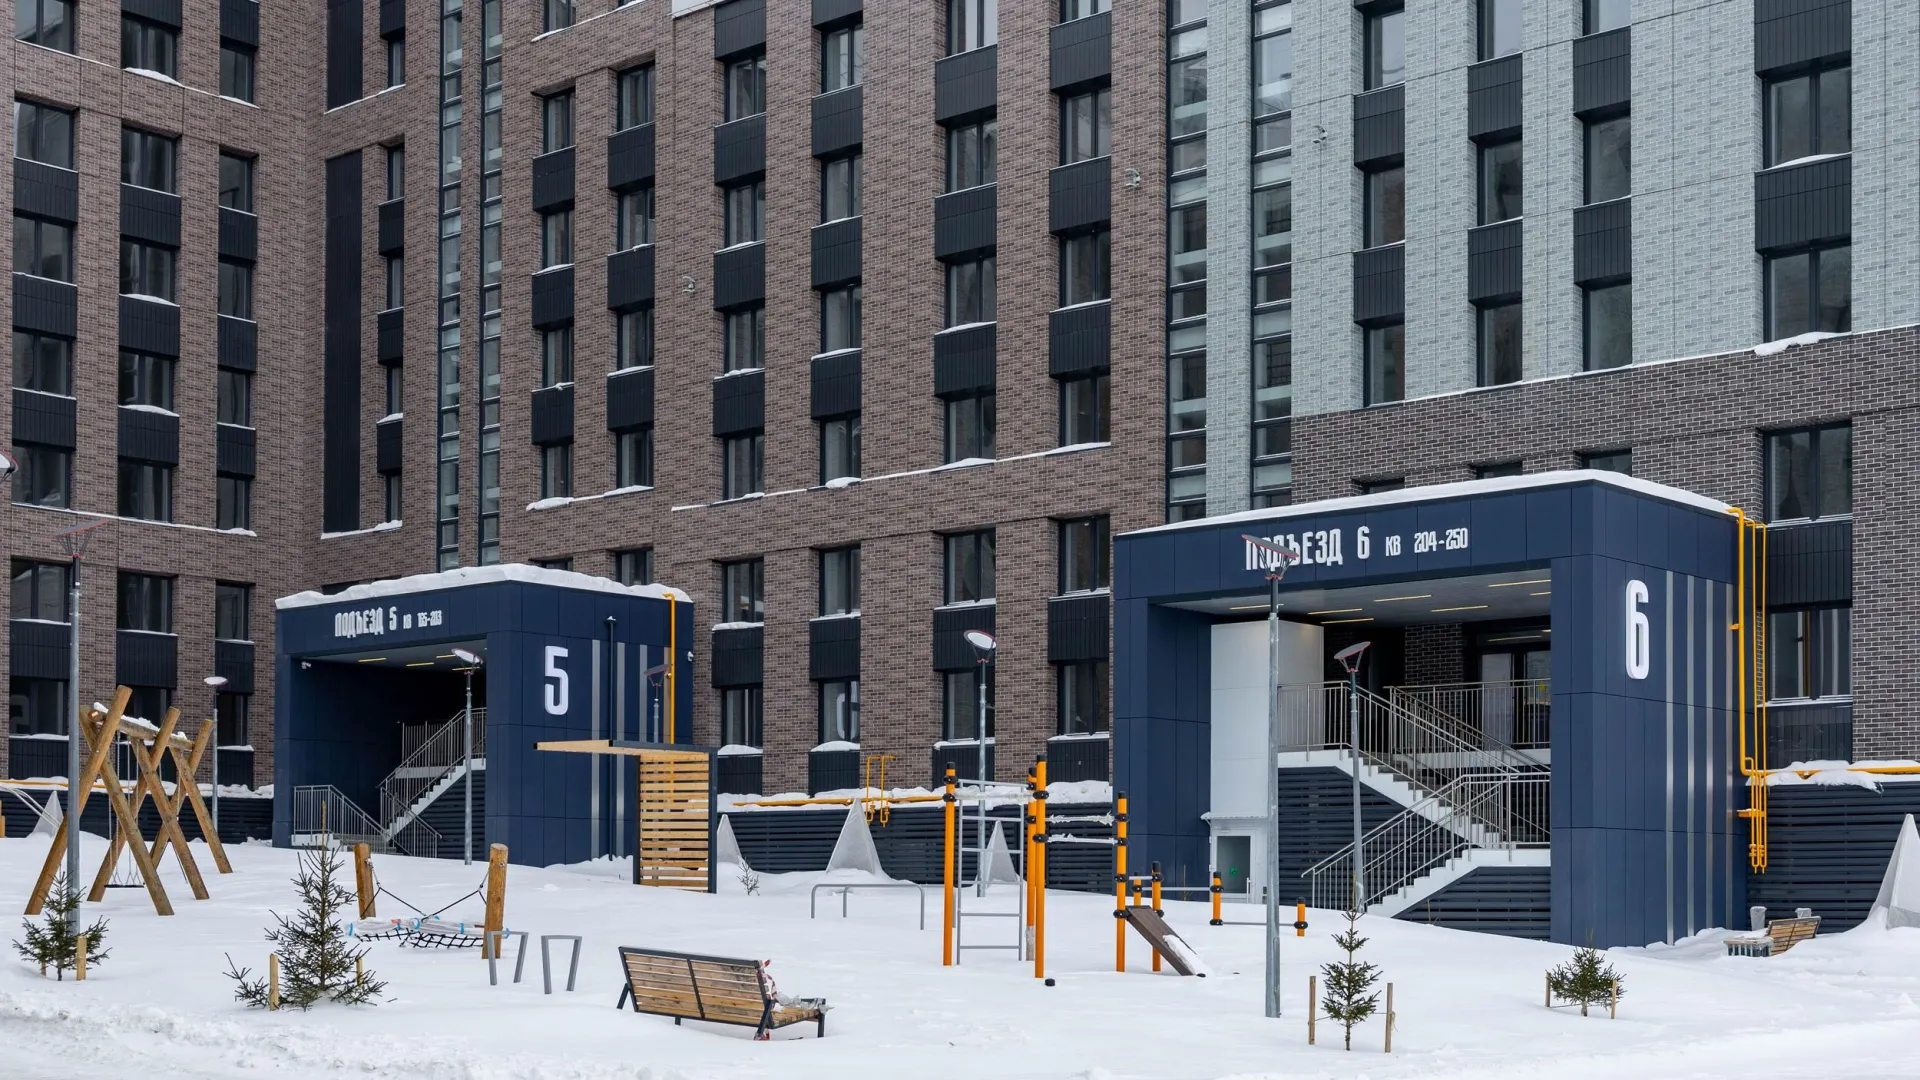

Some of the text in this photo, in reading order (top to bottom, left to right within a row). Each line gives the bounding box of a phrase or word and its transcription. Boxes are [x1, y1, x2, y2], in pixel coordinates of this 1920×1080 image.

[1245, 525, 1469, 572] ПОДЪЕЗД 6 КВ 204-250
[334, 606, 384, 639] ПОДЪЕЗД
[389, 606, 397, 631] 5
[1625, 579, 1651, 681] 6
[544, 645, 569, 716] 5
